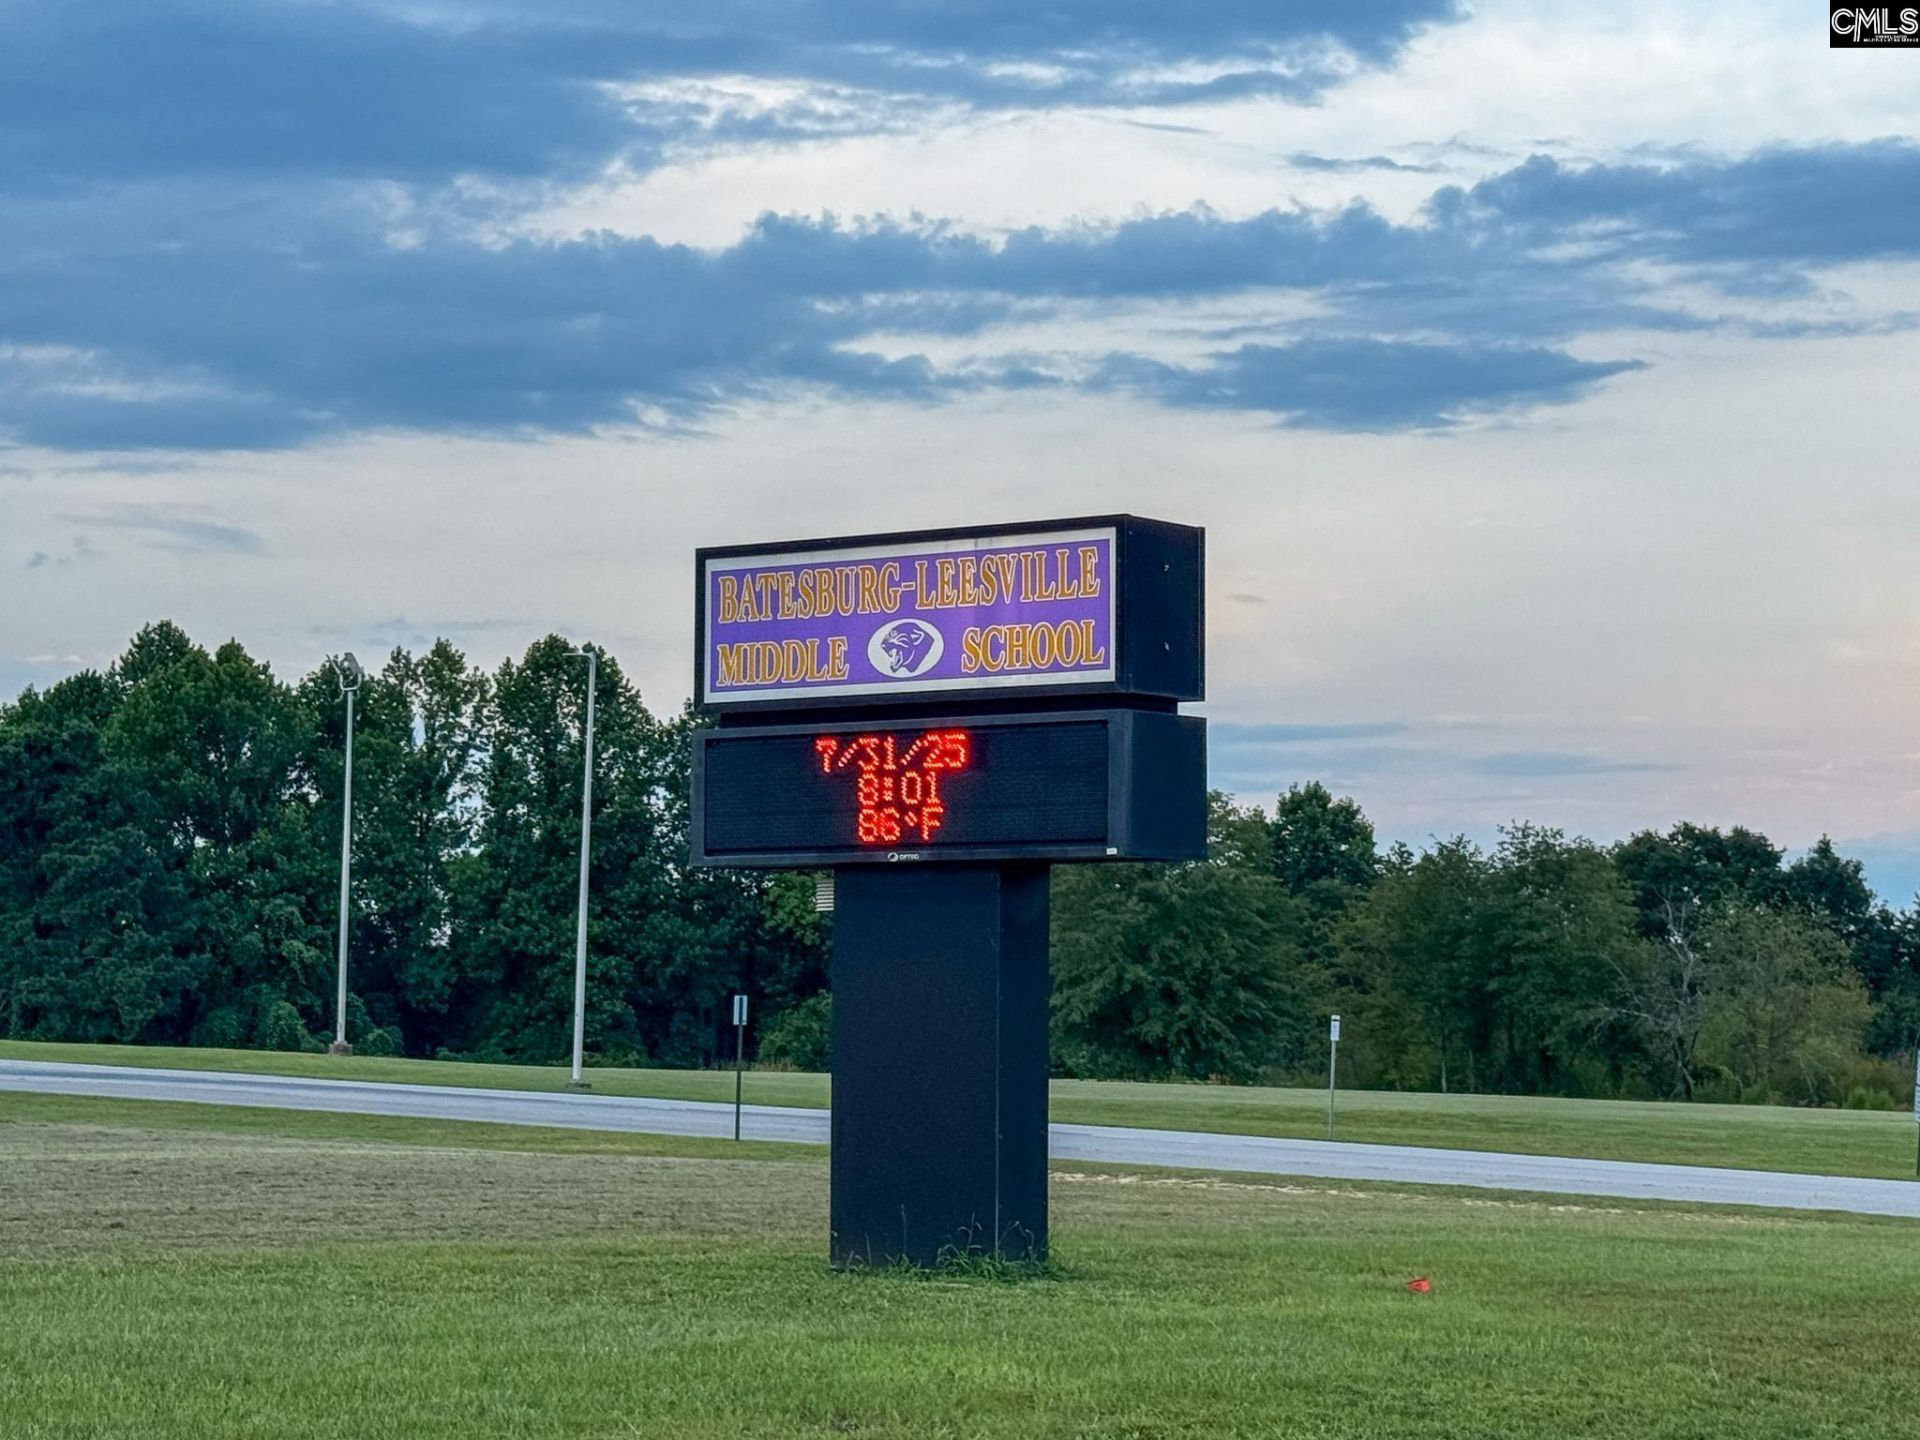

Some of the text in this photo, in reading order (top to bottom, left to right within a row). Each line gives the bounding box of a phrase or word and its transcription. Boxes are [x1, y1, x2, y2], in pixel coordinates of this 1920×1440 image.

[718, 547, 1100, 624] BATESBURG-LEESVILLE
[716, 619, 1105, 687] MIDDLE SCHOOL
[816, 733, 966, 773] 7/31/25
[858, 771, 941, 806] 8:01
